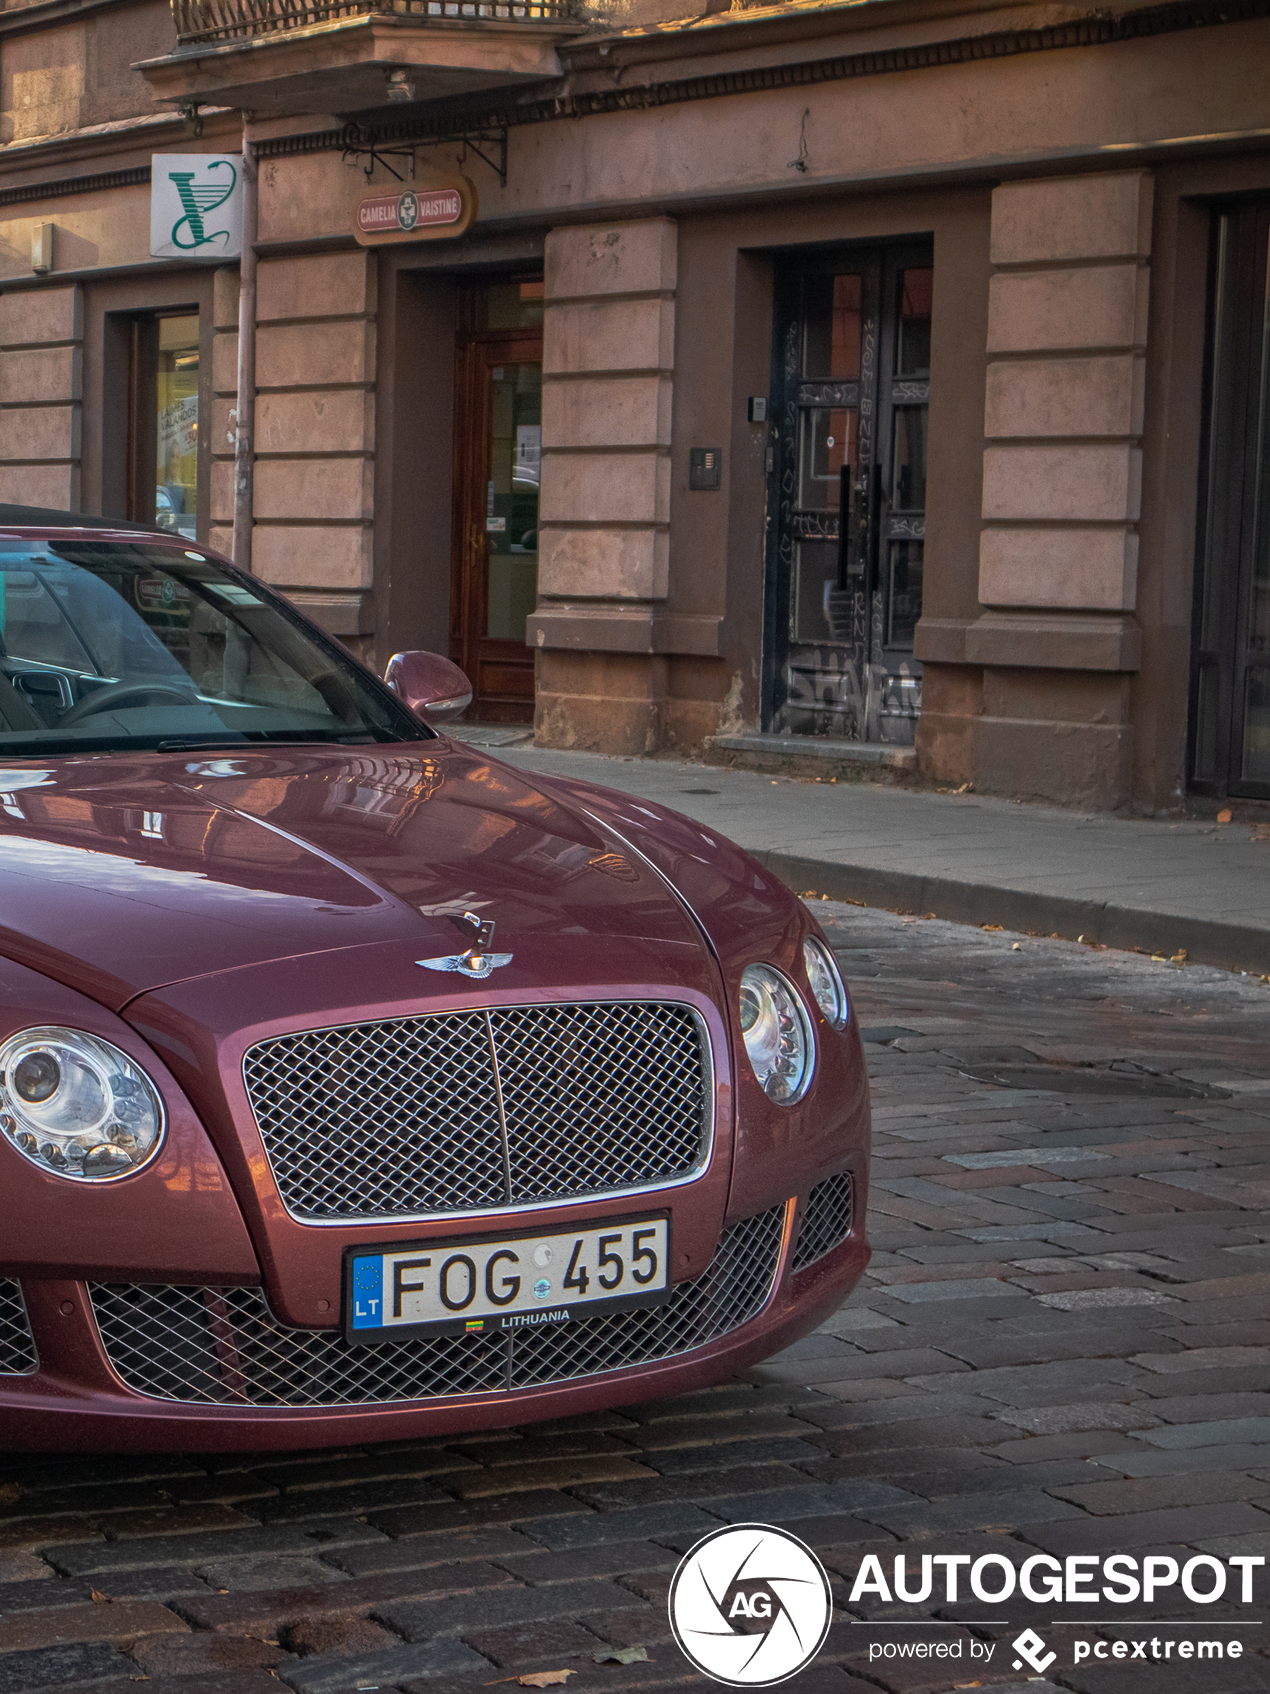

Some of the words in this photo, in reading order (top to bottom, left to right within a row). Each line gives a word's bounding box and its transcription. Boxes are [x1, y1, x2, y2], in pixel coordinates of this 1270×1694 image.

[360, 205, 396, 223] CAMELIA
[420, 197, 457, 216] VAISTINĖ
[392, 1248, 522, 1318] FOG
[563, 1227, 659, 1295] 455
[355, 1299, 380, 1317] LT
[501, 1309, 571, 1329] LITHUANIA
